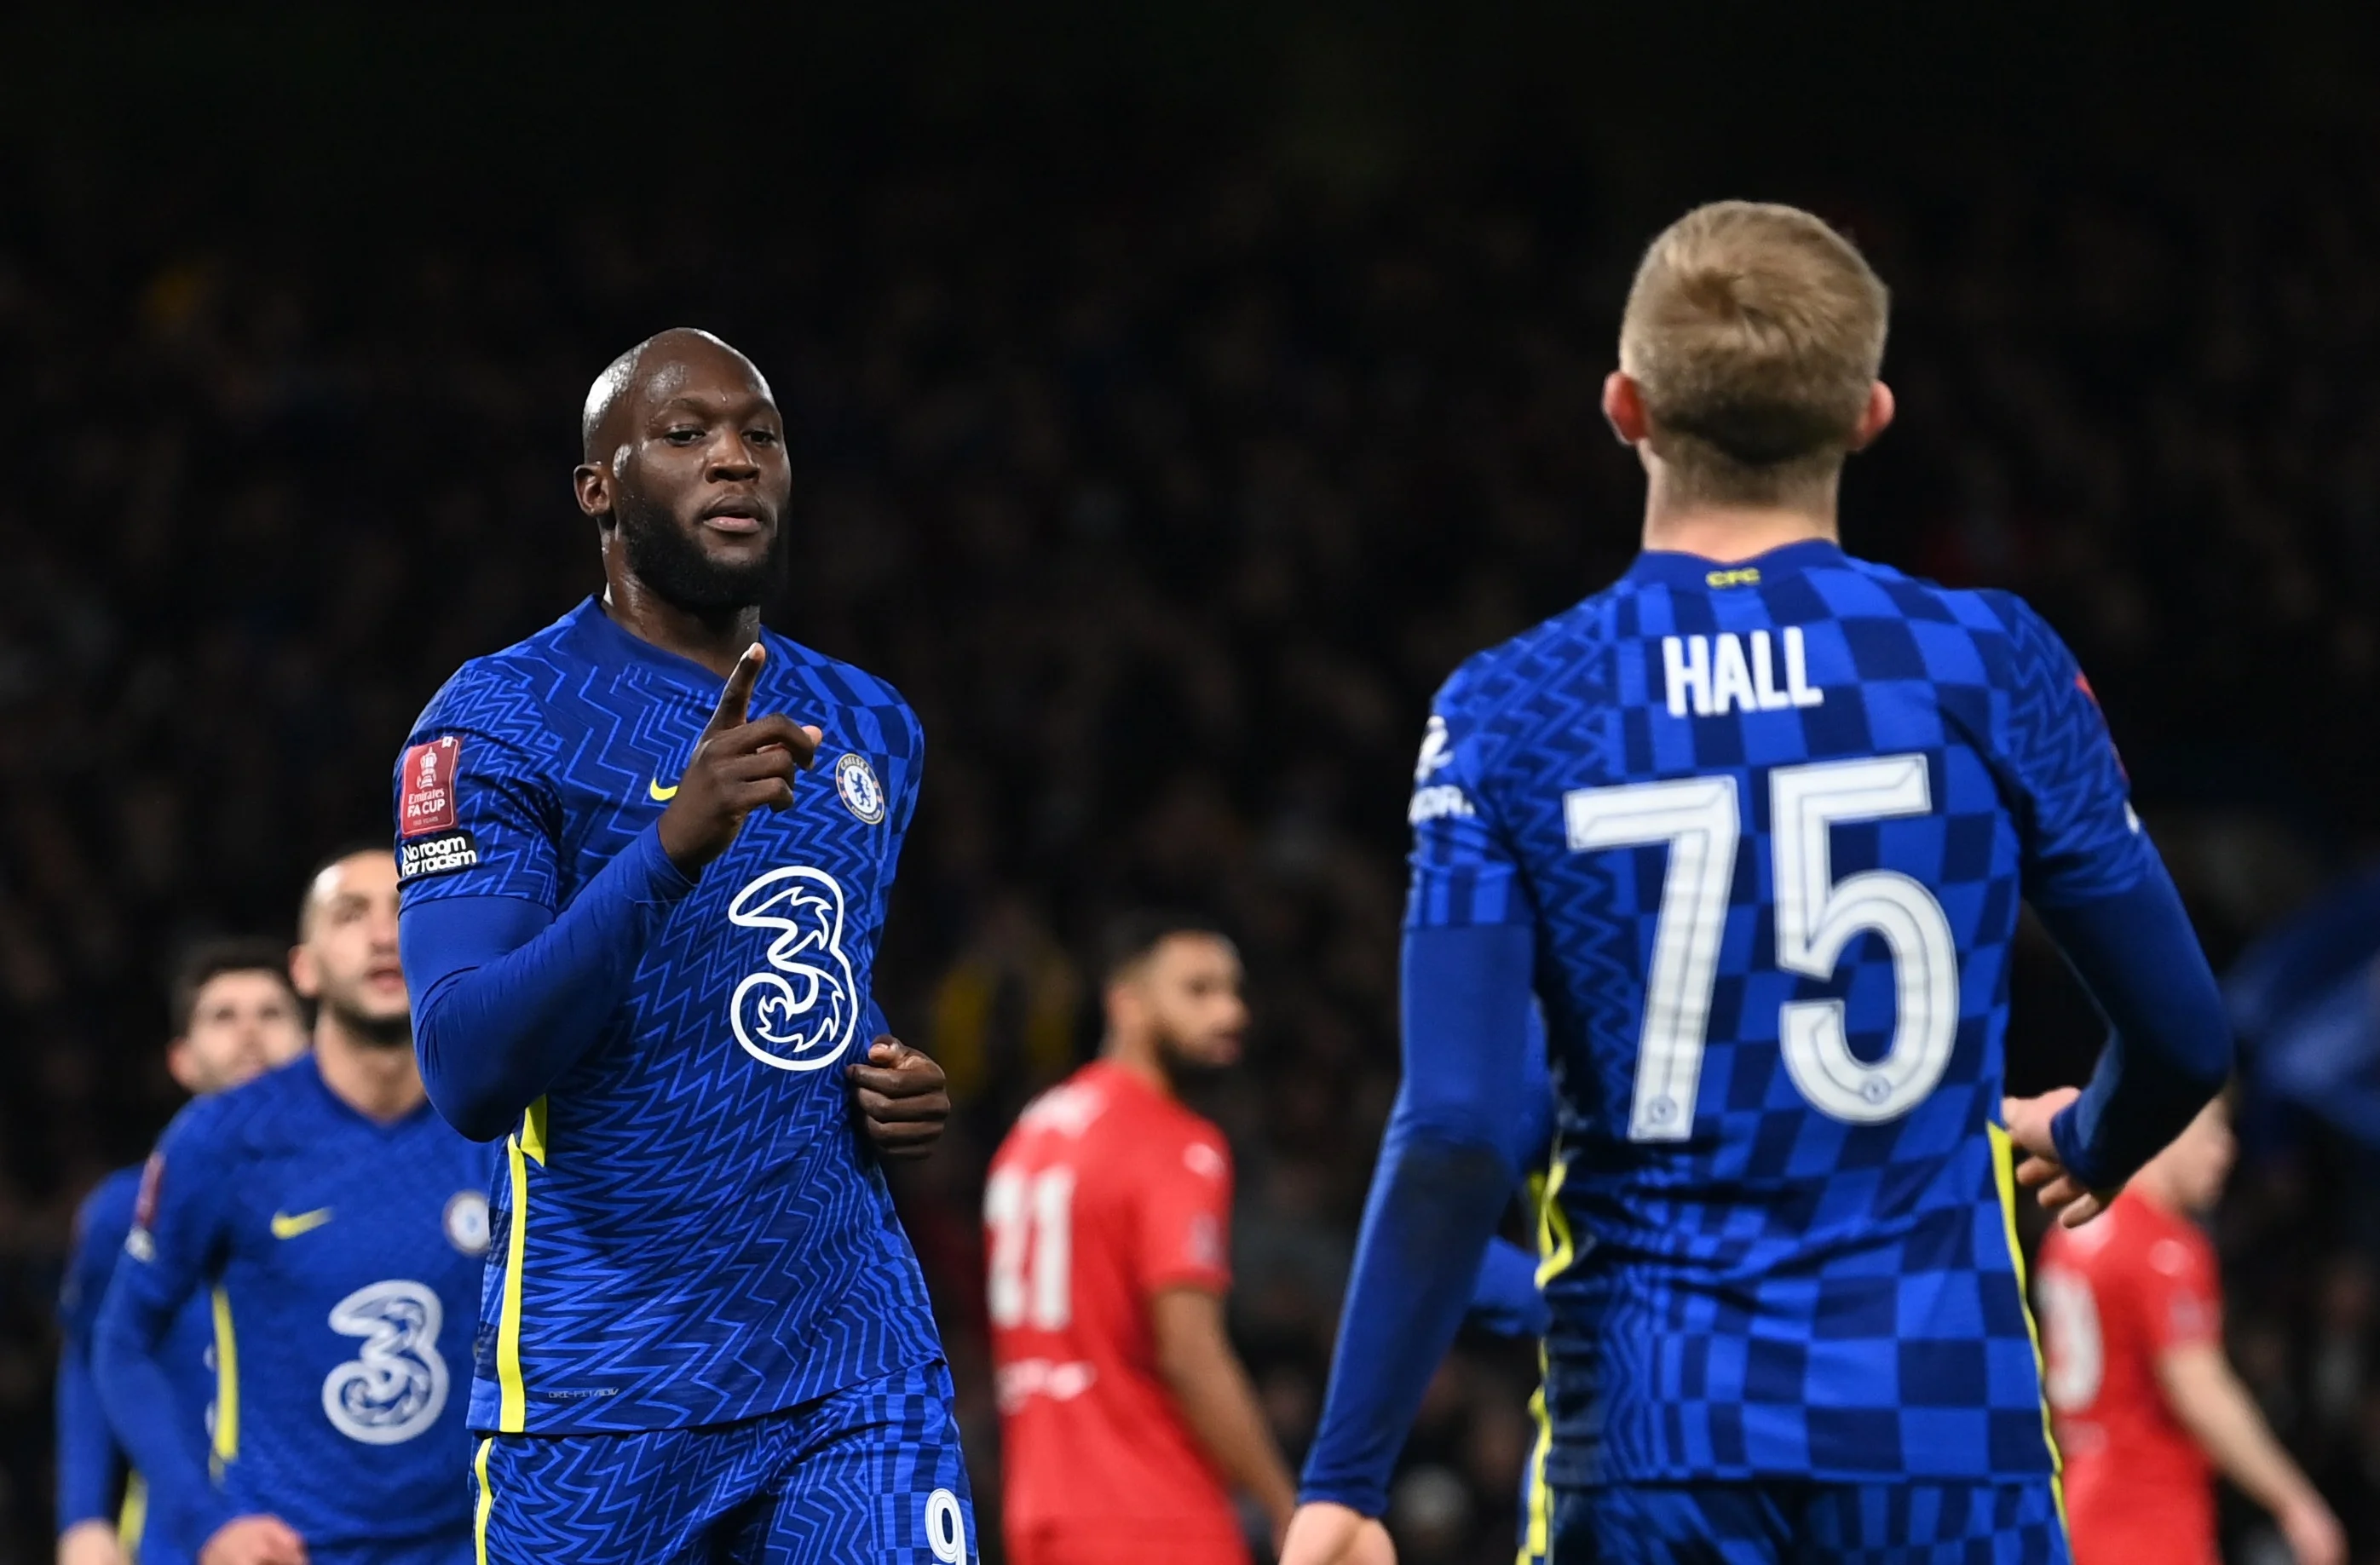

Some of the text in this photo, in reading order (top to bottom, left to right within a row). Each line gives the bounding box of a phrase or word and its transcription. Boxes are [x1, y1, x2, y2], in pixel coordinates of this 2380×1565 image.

[1705, 567, 1761, 590] CFC
[1662, 626, 1824, 718] HALL
[407, 798, 445, 818] FA CUP
[408, 788, 445, 805] Emirates
[401, 837, 466, 861] No room
[401, 849, 477, 877] for racism
[1564, 753, 1961, 1142] 75
[925, 1487, 966, 1565] 9
